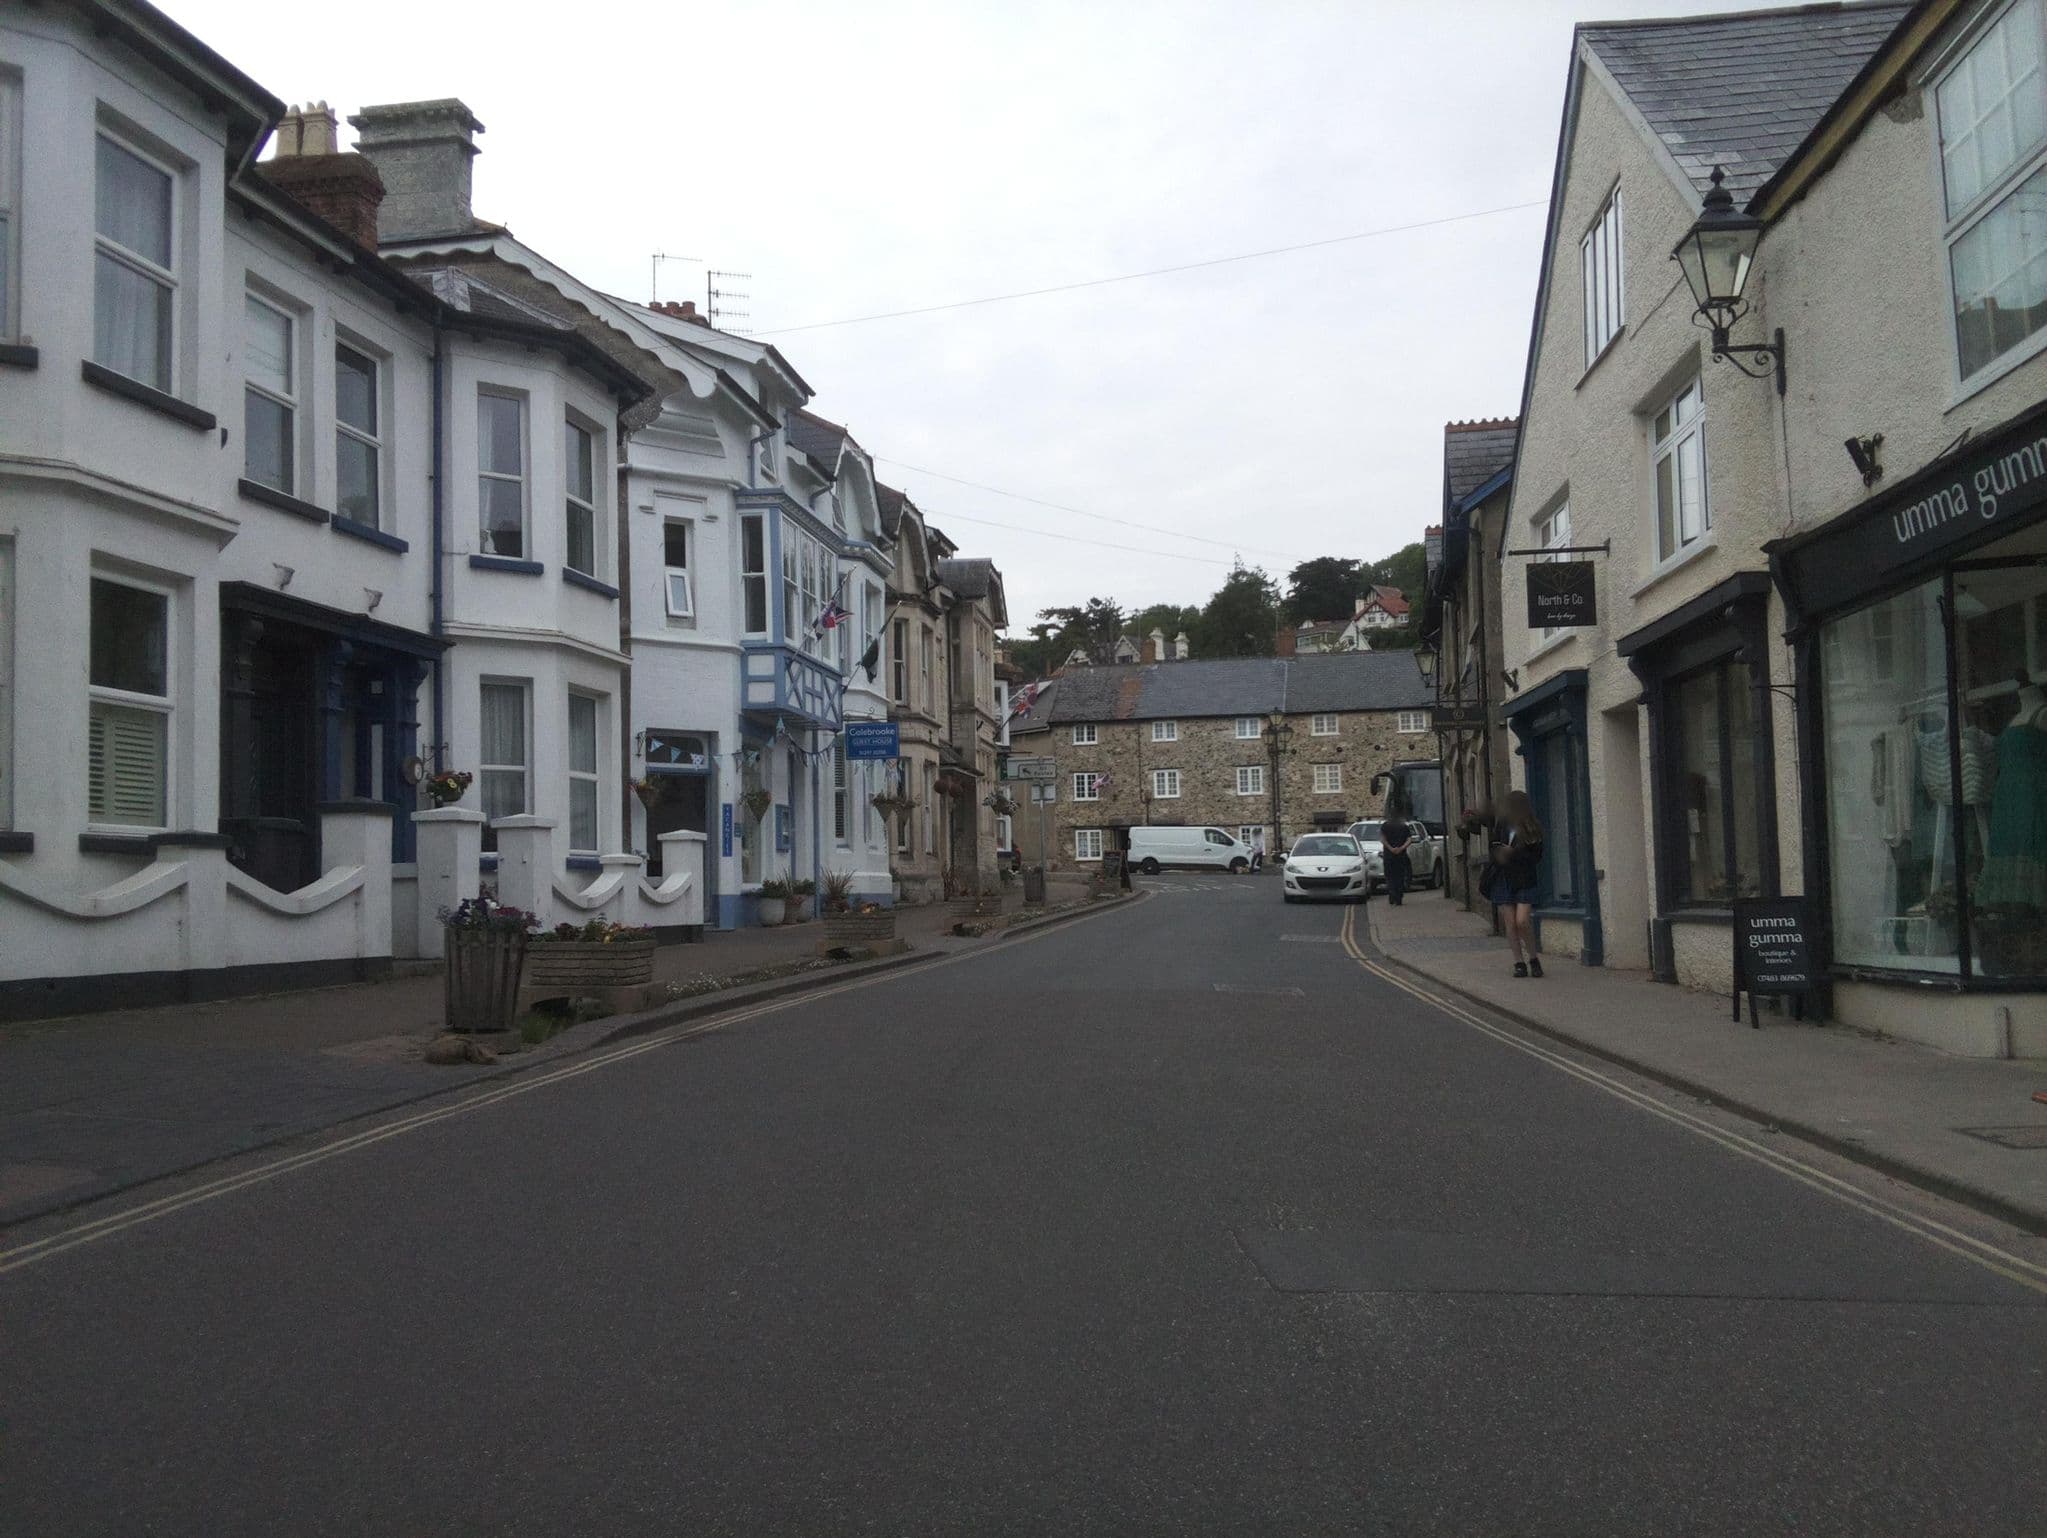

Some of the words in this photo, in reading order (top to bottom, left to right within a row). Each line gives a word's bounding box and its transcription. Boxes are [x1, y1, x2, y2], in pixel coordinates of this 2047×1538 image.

[1893, 482, 1969, 543] umma
[1537, 594, 1562, 606] North
[1563, 594, 1570, 605] &
[1750, 917, 1796, 928] umma
[1749, 933, 1803, 948] gumma
[1758, 949, 1788, 958] boutique
